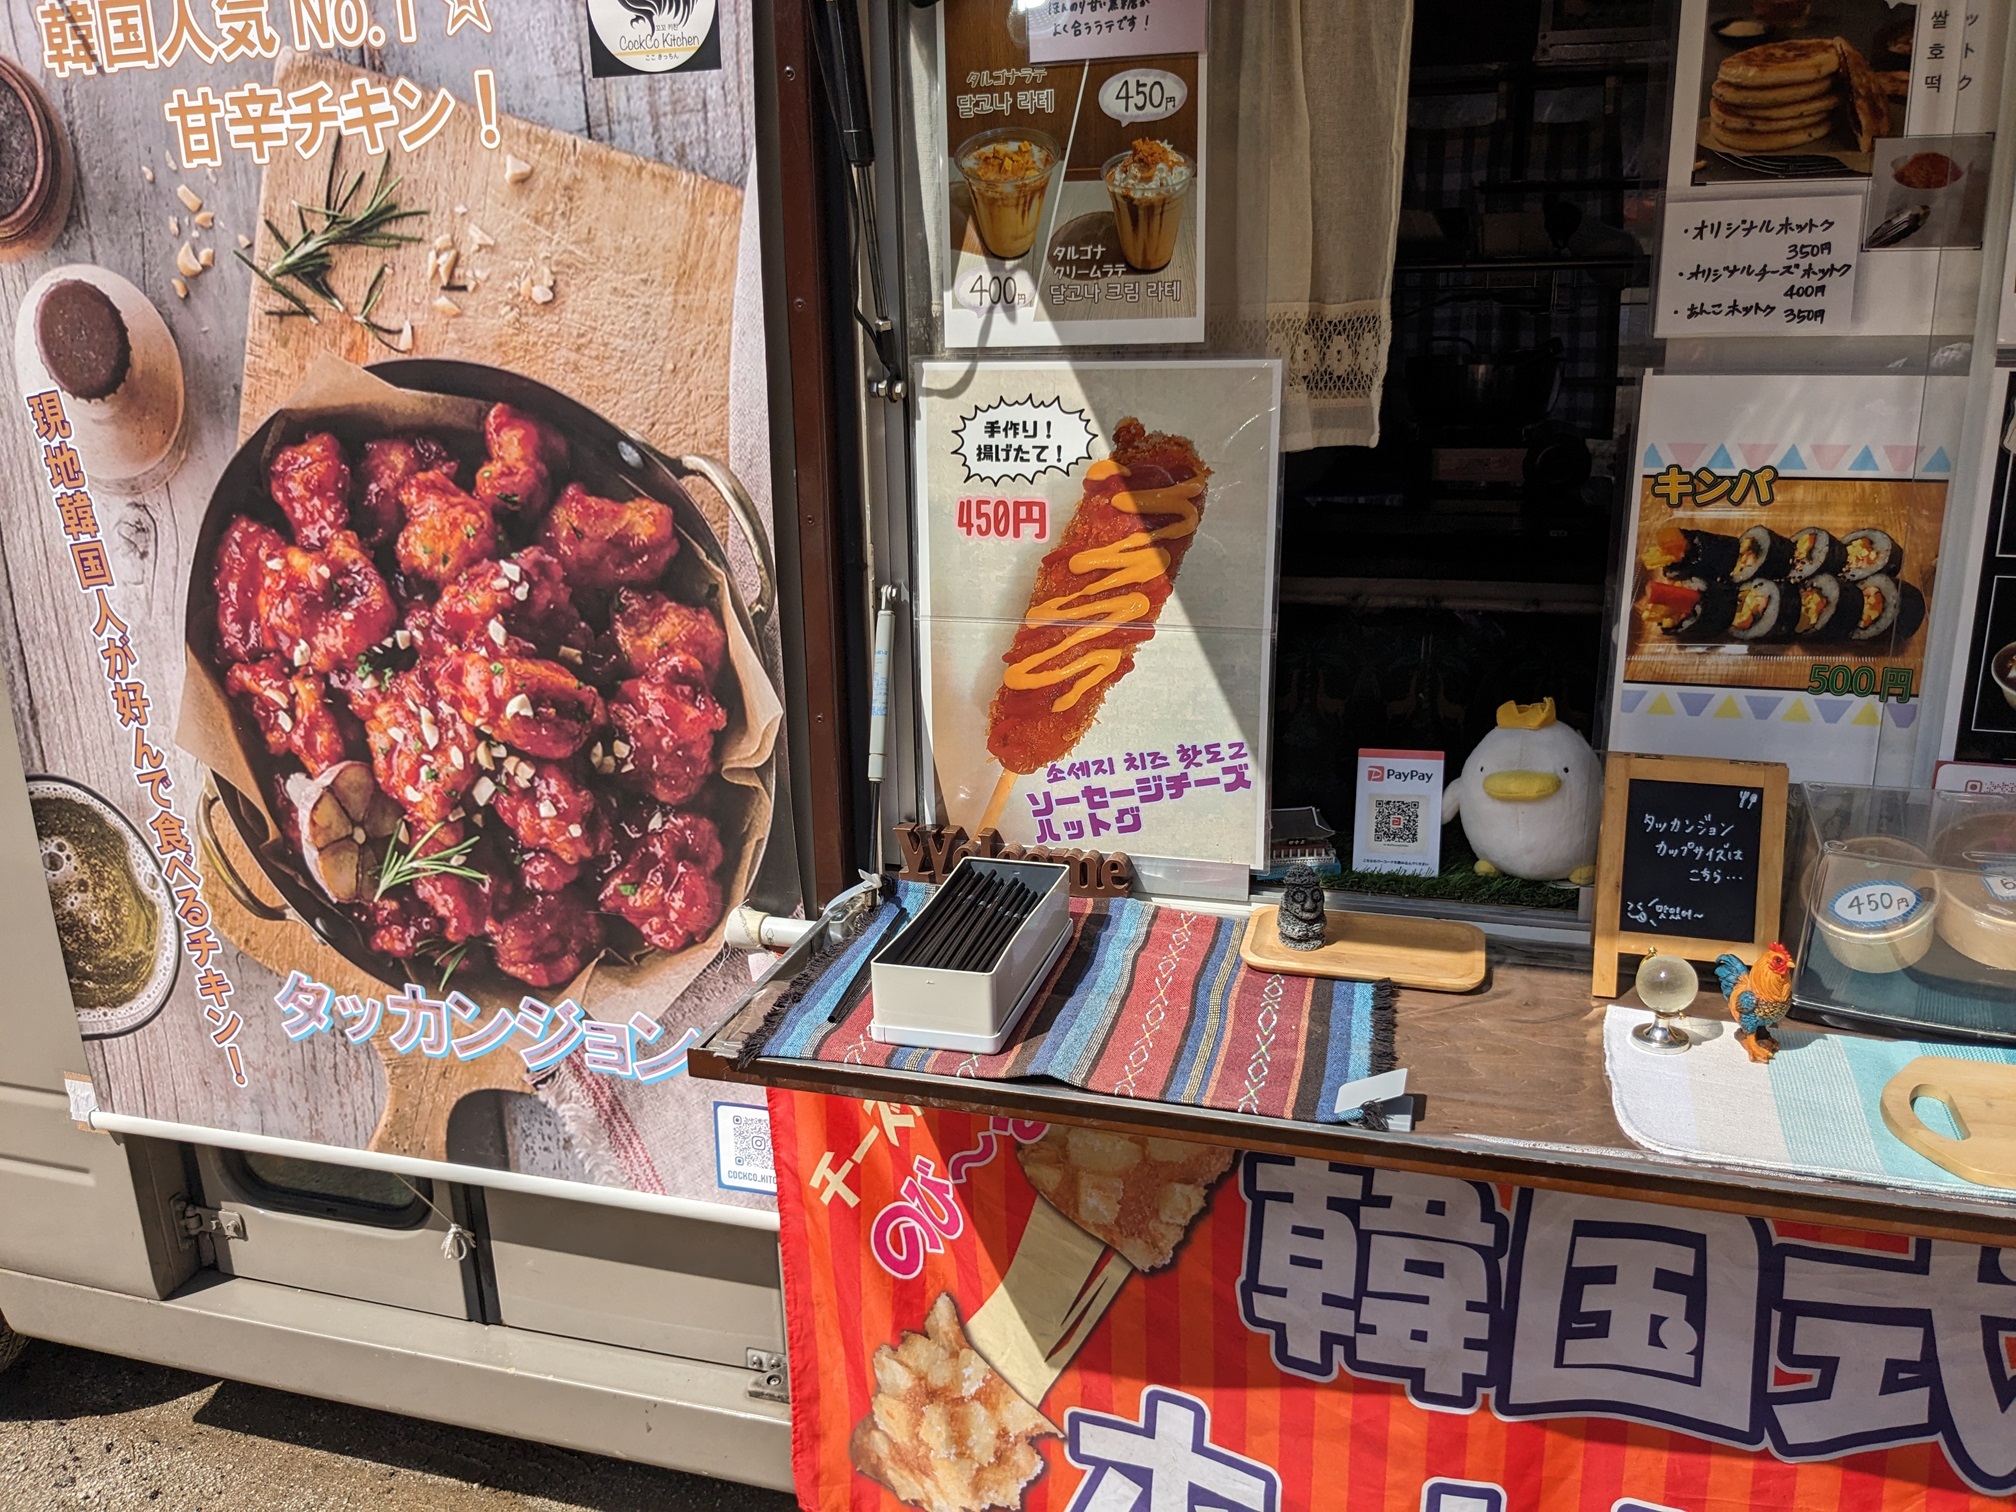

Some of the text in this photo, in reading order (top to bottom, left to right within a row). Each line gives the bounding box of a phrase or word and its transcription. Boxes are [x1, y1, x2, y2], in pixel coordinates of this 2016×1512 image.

[36, 0, 281, 78] 韓国人気
[620, 32, 700, 51] CockCo Kitchen
[966, 67, 1047, 89] タルゴナラテ
[956, 88, 1055, 119] 달고나 라테
[1114, 79, 1177, 113] 450円
[164, 68, 501, 171] 甘辛チキン！
[1052, 244, 1106, 261] タルゴナ
[1785, 241, 1832, 260] 350円
[1053, 264, 1126, 280] クリームラテ
[969, 274, 1027, 307] 400円
[1049, 280, 1181, 305] 달고나 크림 라테
[1782, 284, 1827, 300] 400円
[1783, 308, 1826, 325] 350円
[984, 420, 1053, 440] 手作り！
[976, 444, 1063, 463] 揚げたて！
[1652, 464, 1779, 508] キンパ
[957, 499, 1048, 540] 450円
[26, 387, 250, 1088] 現地韓国人が好んで食べるチキン！
[1046, 757, 1116, 785] 소세지
[1123, 751, 1171, 772] 치즈
[1386, 768, 1434, 783] PayPay
[1025, 763, 1253, 818] ソーセージチーズ
[1035, 806, 1143, 845] ハットグ
[1643, 814, 1734, 837] タッカンジョン
[1655, 841, 1744, 862] カップサイズは
[1847, 892, 1910, 915] 450円
[274, 968, 701, 1085] タッカンジョン
[1237, 1147, 2016, 1497] 韓国式
